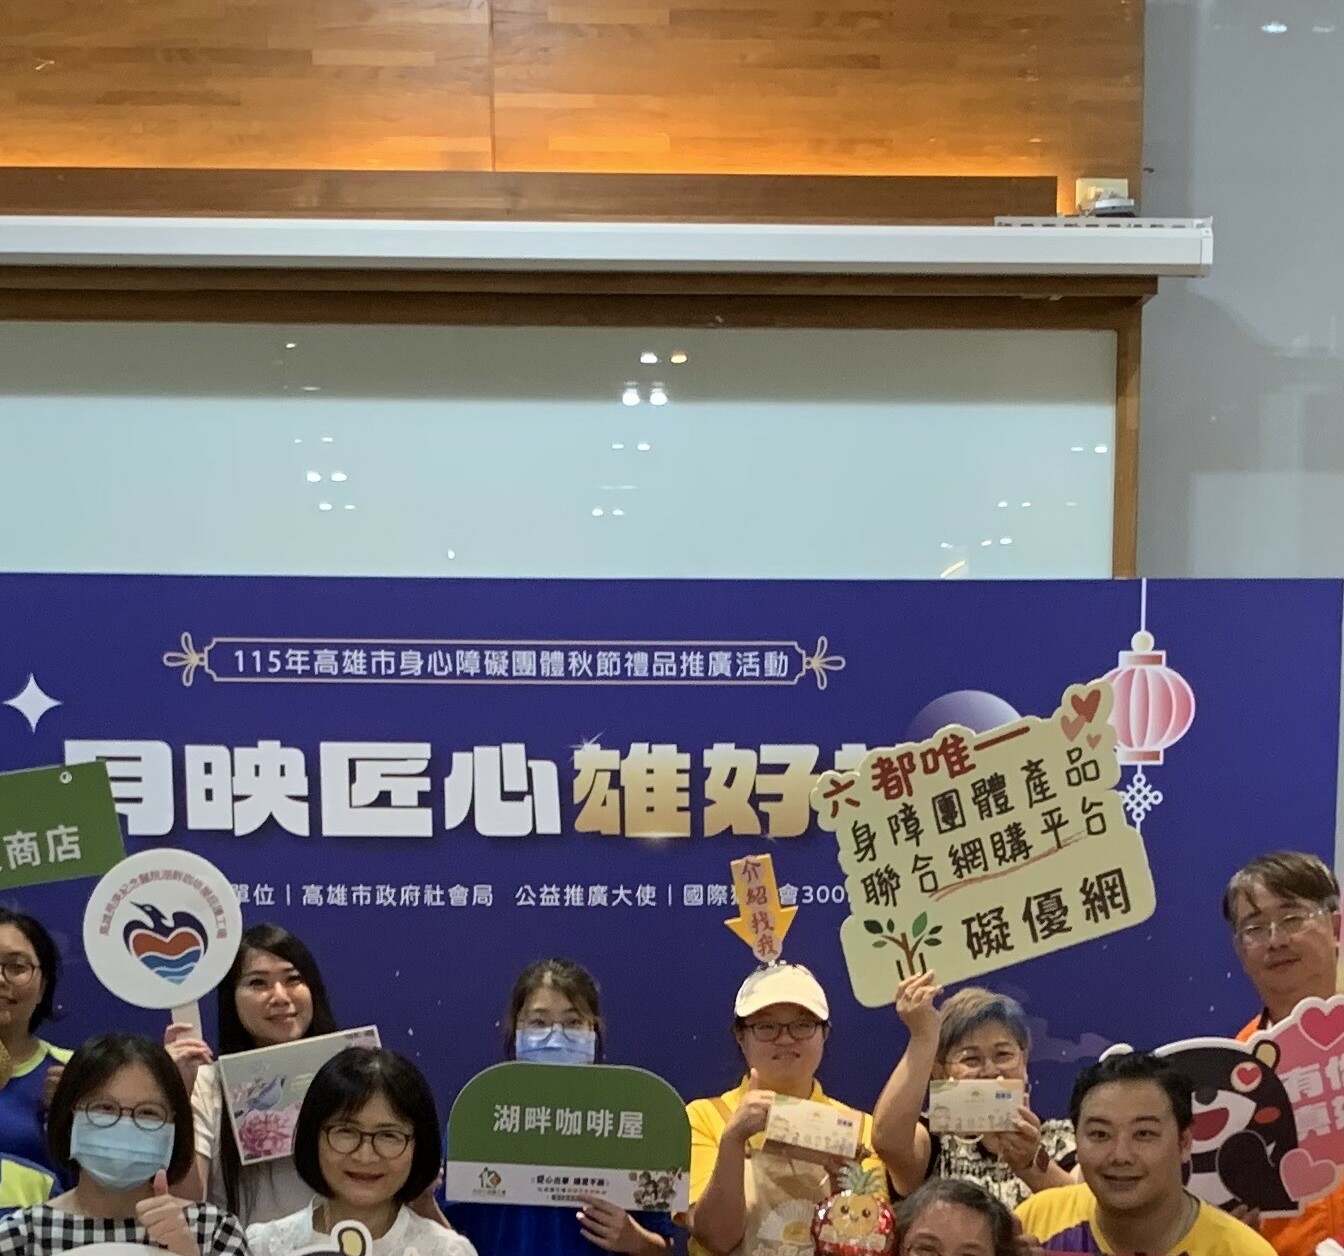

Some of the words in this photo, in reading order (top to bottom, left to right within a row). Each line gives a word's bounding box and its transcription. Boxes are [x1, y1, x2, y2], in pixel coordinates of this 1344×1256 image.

[234, 648, 789, 678] 115年高雄市身心障礙團體秋節禮品推廣活動
[64, 738, 871, 838] 月映匠心雄好
[823, 727, 1031, 818] 六都唯一
[852, 747, 1100, 864] 身障團體產品
[302, 883, 494, 907] 高雄市政府社會局
[515, 883, 657, 907] 公益推廣大使
[861, 796, 1106, 907] 聯合網購平台
[961, 868, 1132, 960] 礙優網
[493, 1104, 644, 1140] 湖畔咖啡屋
